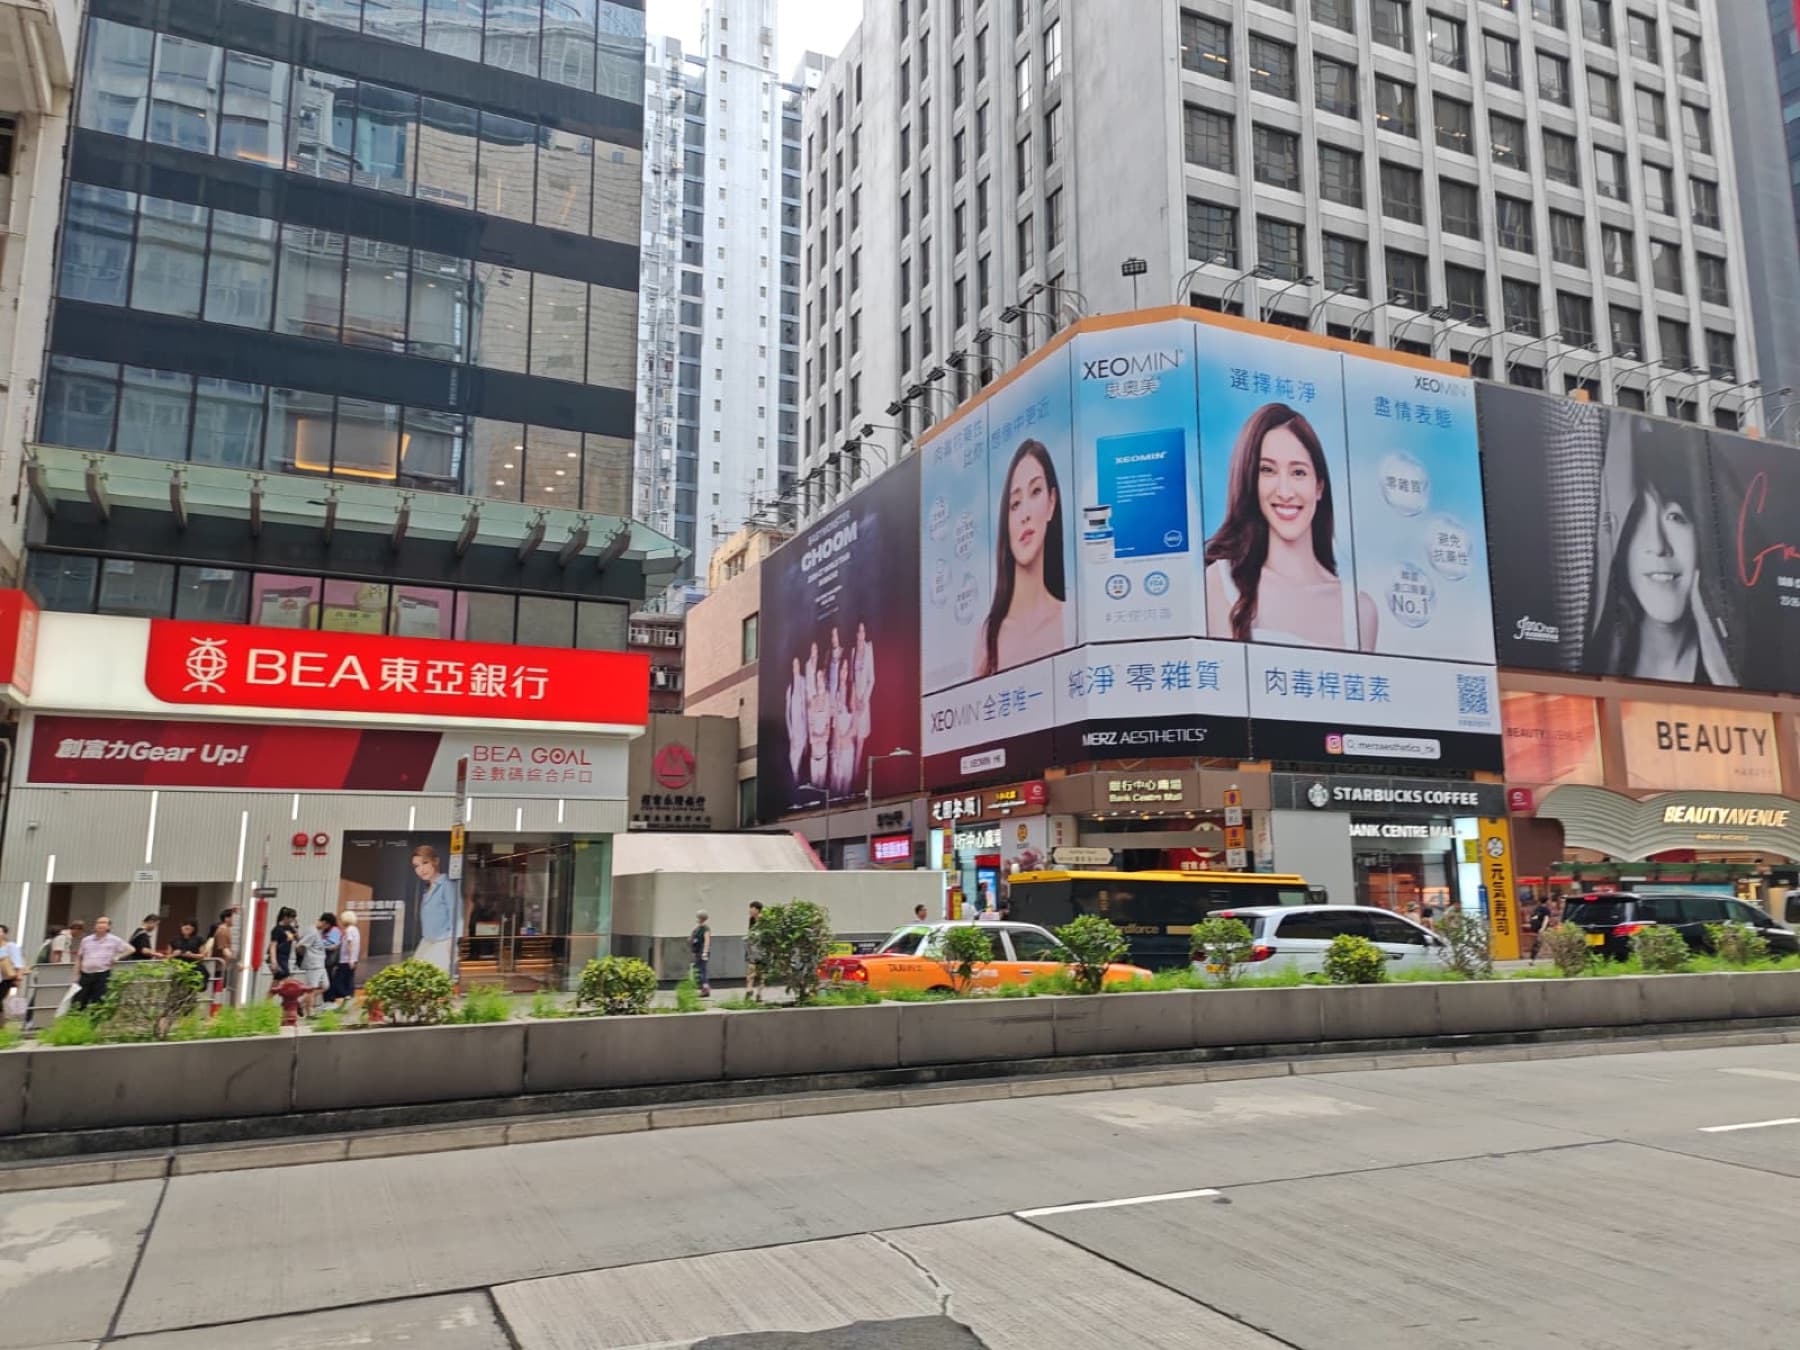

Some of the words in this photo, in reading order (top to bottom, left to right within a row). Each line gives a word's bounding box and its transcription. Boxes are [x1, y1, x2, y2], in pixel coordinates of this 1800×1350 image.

[1083, 350, 1180, 380] XEOMIN
[1229, 368, 1316, 402] 選擇純淨
[1414, 375, 1467, 398] XEOMIN
[245, 648, 370, 690] BEA
[379, 657, 549, 700] 東亞銀行
[1126, 660, 1221, 693] 零雜質
[1264, 668, 1391, 702] 肉毒桿菌素
[1082, 731, 1117, 746] MERZ
[1656, 720, 1768, 757] BEAUTY
[200, 744, 248, 766] Up!
[473, 746, 523, 763] BEA
[531, 747, 592, 766] GOAL
[471, 766, 593, 783] 全數碼綜合戶口
[1333, 786, 1423, 804] STARBUCKS
[1423, 790, 1479, 806] COFFEE
[1381, 824, 1429, 837] CENTRE
